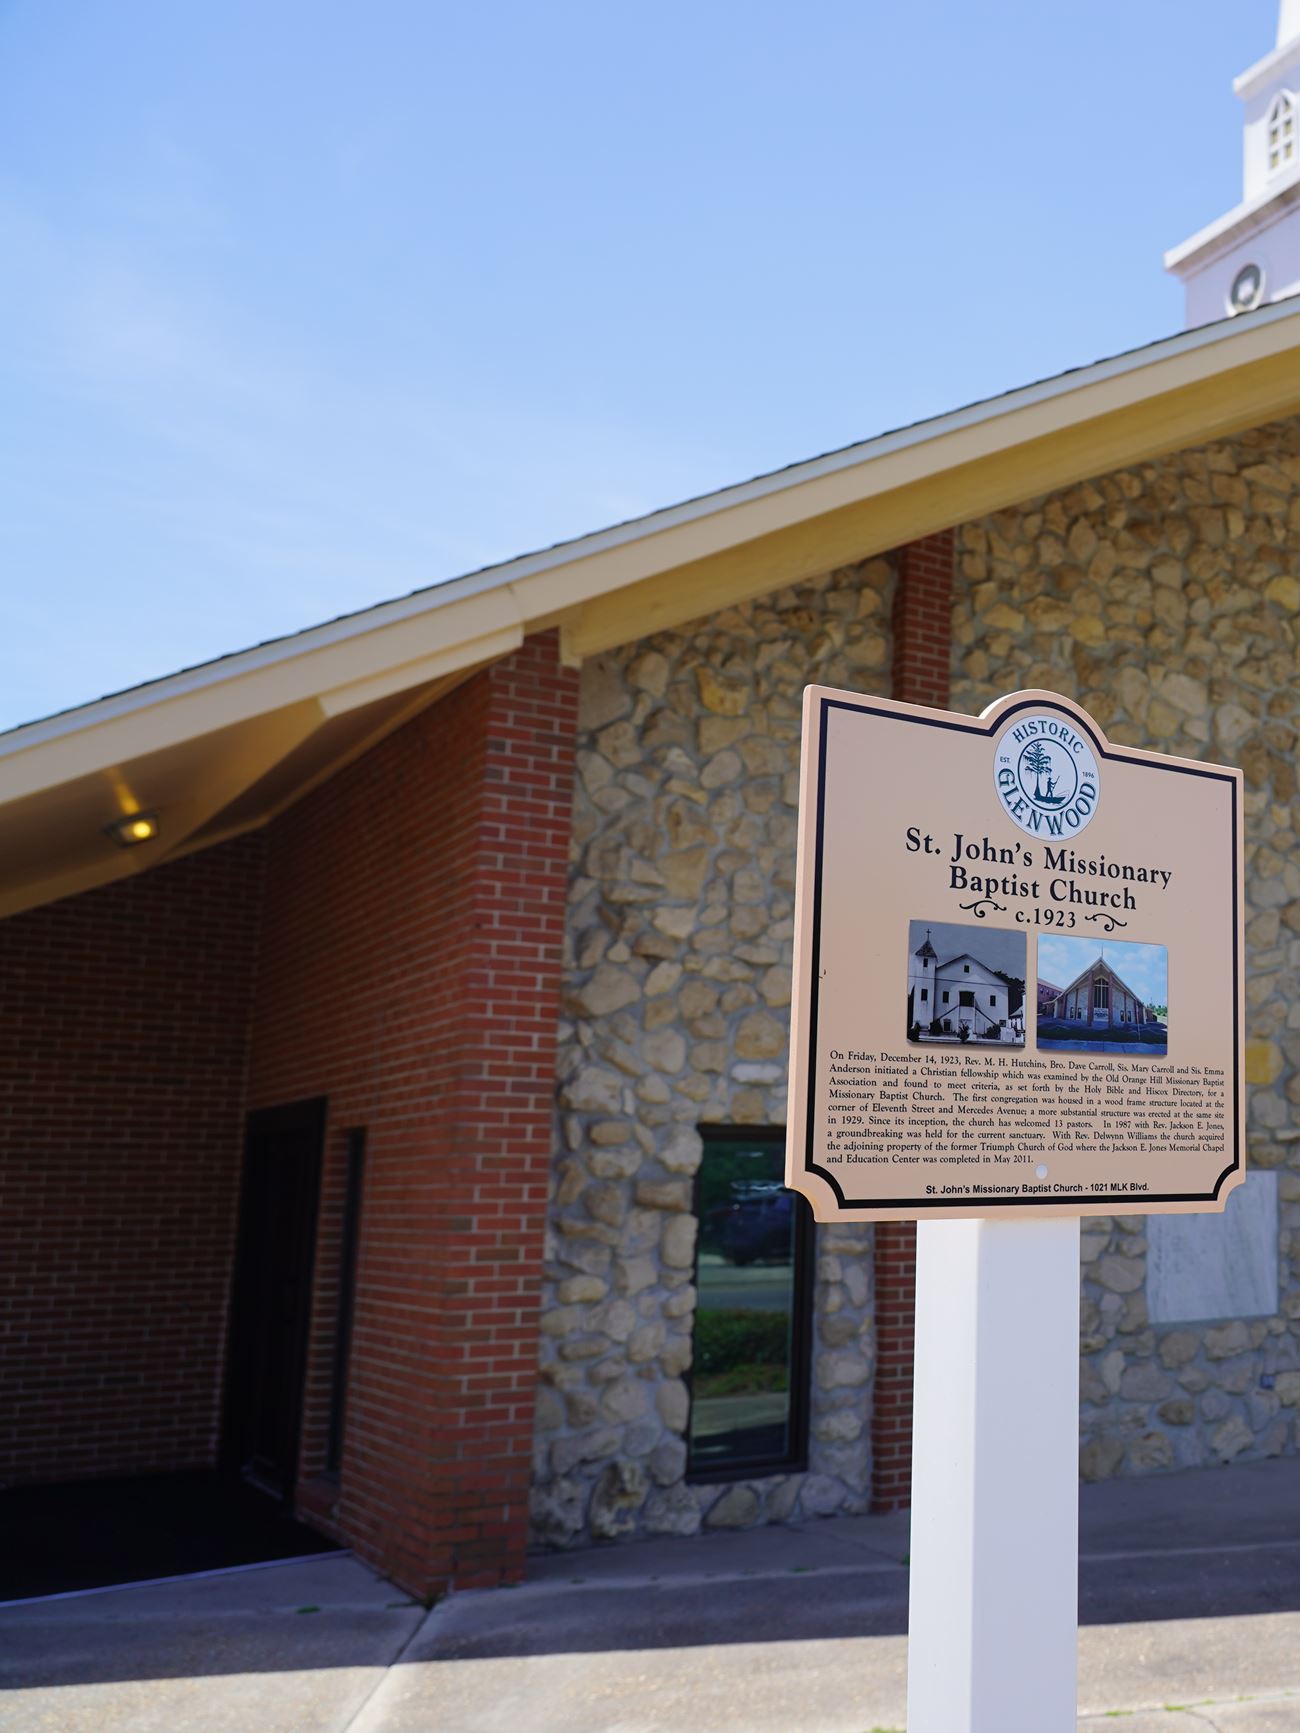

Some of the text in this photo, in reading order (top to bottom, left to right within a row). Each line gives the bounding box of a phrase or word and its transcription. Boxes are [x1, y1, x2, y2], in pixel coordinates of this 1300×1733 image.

[1012, 720, 1084, 754] HISTORIC
[998, 768, 1096, 836] GLENWOOD
[905, 826, 1172, 890] St. John's Missionary
[949, 865, 1137, 910] Baptist Church
[1015, 908, 1076, 928] c.1923
[830, 1051, 845, 1060] On
[848, 1052, 877, 1064] Friday,
[880, 1053, 922, 1063] December
[925, 1055, 937, 1065] 14,
[941, 1055, 962, 1066] 1923,
[964, 1056, 981, 1065] Rev.
[984, 1057, 996, 1066] M.
[998, 1058, 1008, 1066] H.
[1011, 1058, 1047, 1069] Hutchins,
[1050, 1060, 1066, 1068] Bro.
[1068, 1060, 1087, 1069] Dave
[1088, 1061, 1115, 1072] Carroll,
[1131, 1063, 1150, 1074] Mary
[1151, 1064, 1175, 1073] Carroll
[1204, 1066, 1225, 1075] Emma
[829, 1064, 871, 1074] Anderson
[874, 1066, 909, 1075] initiated
[920, 1068, 958, 1077] Christian
[960, 1069, 1000, 1081] fellowship
[1002, 1070, 1024, 1079] which
[1043, 1072, 1078, 1081] examined
[1105, 1074, 1120, 1083] Old
[1121, 1074, 1147, 1086] Orange
[1149, 1075, 1163, 1084] Hill
[1165, 1076, 1201, 1088] Missionary
[1202, 1077, 1225, 1089] Baptist
[828, 1077, 1217, 1099] Association found meet criteria, set forth Holy Bible Hiscox Directory, for
[829, 1090, 876, 1102] Missionary
[879, 1092, 909, 1103] Baptist
[912, 1092, 945, 1101] Church.
[952, 1093, 969, 1102] The
[972, 1094, 988, 1102] first
[990, 1094, 1039, 1106] congregation
[1058, 1096, 1084, 1105] housed
[1104, 1097, 1124, 1106] wood
[1126, 1097, 1146, 1106] frame
[1149, 1098, 1178, 1107] structure
[1180, 1099, 1203, 1107] located
[872, 1104, 908, 1113] Eleventh
[911, 1105, 935, 1113] Street
[957, 1105, 994, 1114] Mercedes
[1060, 1107, 1098, 1116] substantial
[1100, 1108, 1131, 1117] structure
[1148, 1109, 1171, 1118] erected
[1214, 1110, 1225, 1119] site
[842, 1116, 865, 1125] 1929.
[868, 1117, 891, 1125] Since
[895, 1117, 905, 1126] its
[908, 1117, 949, 1128] inception,
[952, 1118, 965, 1126] the
[968, 1118, 995, 1127] church
[998, 1119, 1012, 1127] has
[1014, 1119, 1051, 1128] welcomed
[1055, 1119, 1063, 1128] 13
[1103, 1120, 1112, 1128] In
[1115, 1120, 1132, 1129] 1987
[1134, 1120, 1150, 1129] with
[1153, 1120, 1167, 1129] Rev.
[1169, 1121, 1194, 1132] Jackson
[1197, 1121, 1204, 1129] E.
[1206, 1121, 1225, 1132] Jones,
[836, 1129, 903, 1140] groundbreaking
[925, 1130, 943, 1138] held
[946, 1130, 959, 1138] for
[961, 1130, 975, 1138] the
[977, 1130, 1006, 1139] current
[1009, 1130, 1046, 1141] sanctuary.
[1052, 1131, 1071, 1139] With
[1075, 1131, 1090, 1139] Rev.
[1093, 1131, 1124, 1142] Delwynn
[1127, 1131, 1158, 1140] Williams
[1160, 1132, 1171, 1140] the
[1173, 1132, 1196, 1140] church
[1198, 1132, 1225, 1142] acquired
[827, 1142, 1225, 1154] the adjoining property the former Triumph Church God where the Jackson E. Jones Memorial Chapel
[846, 1155, 889, 1163] Education
[891, 1155, 921, 1163] Center
[939, 1155, 980, 1165] completed
[994, 1155, 1011, 1165] May
[1013, 1155, 1034, 1163] 2011.
[925, 1182, 1150, 1196] St. John's Missionary Baptist Church 1021 MLK Blvd.
